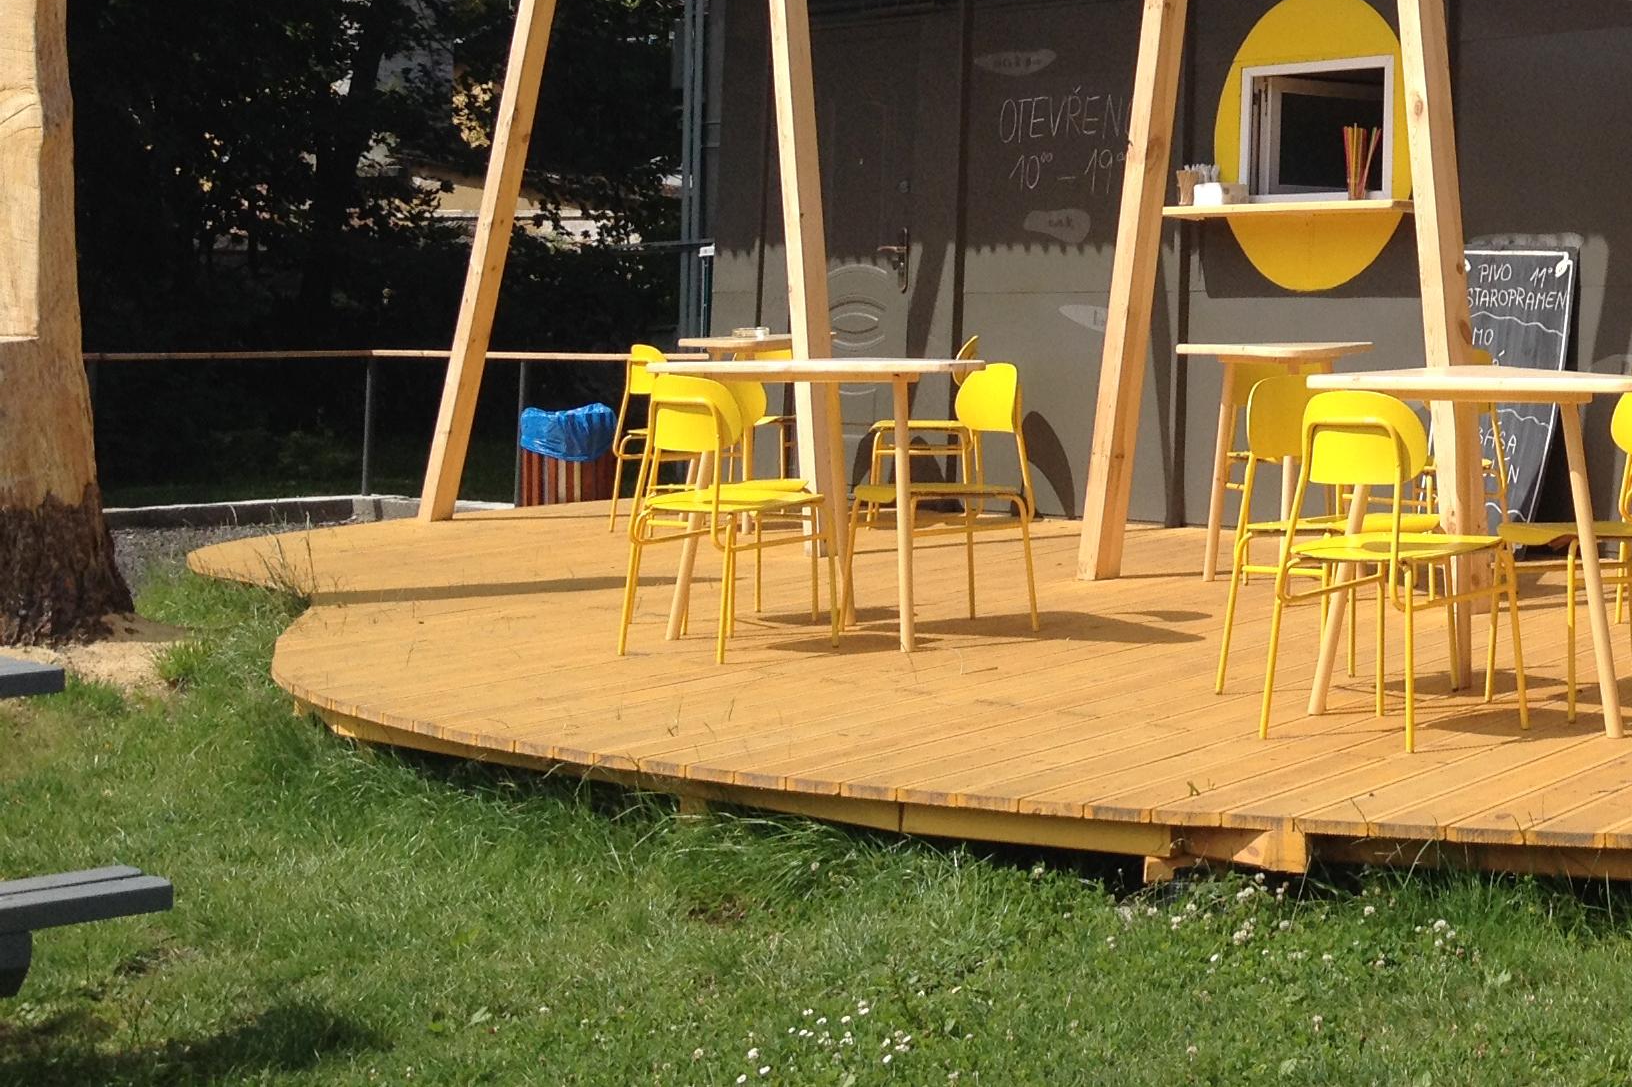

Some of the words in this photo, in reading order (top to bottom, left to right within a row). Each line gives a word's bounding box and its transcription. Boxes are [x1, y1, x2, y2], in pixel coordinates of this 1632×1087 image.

[999, 85, 1130, 144] OTEVŘEN
[1478, 263, 1512, 283] PIVO
[1467, 287, 1567, 311] STAROPRAMEN
